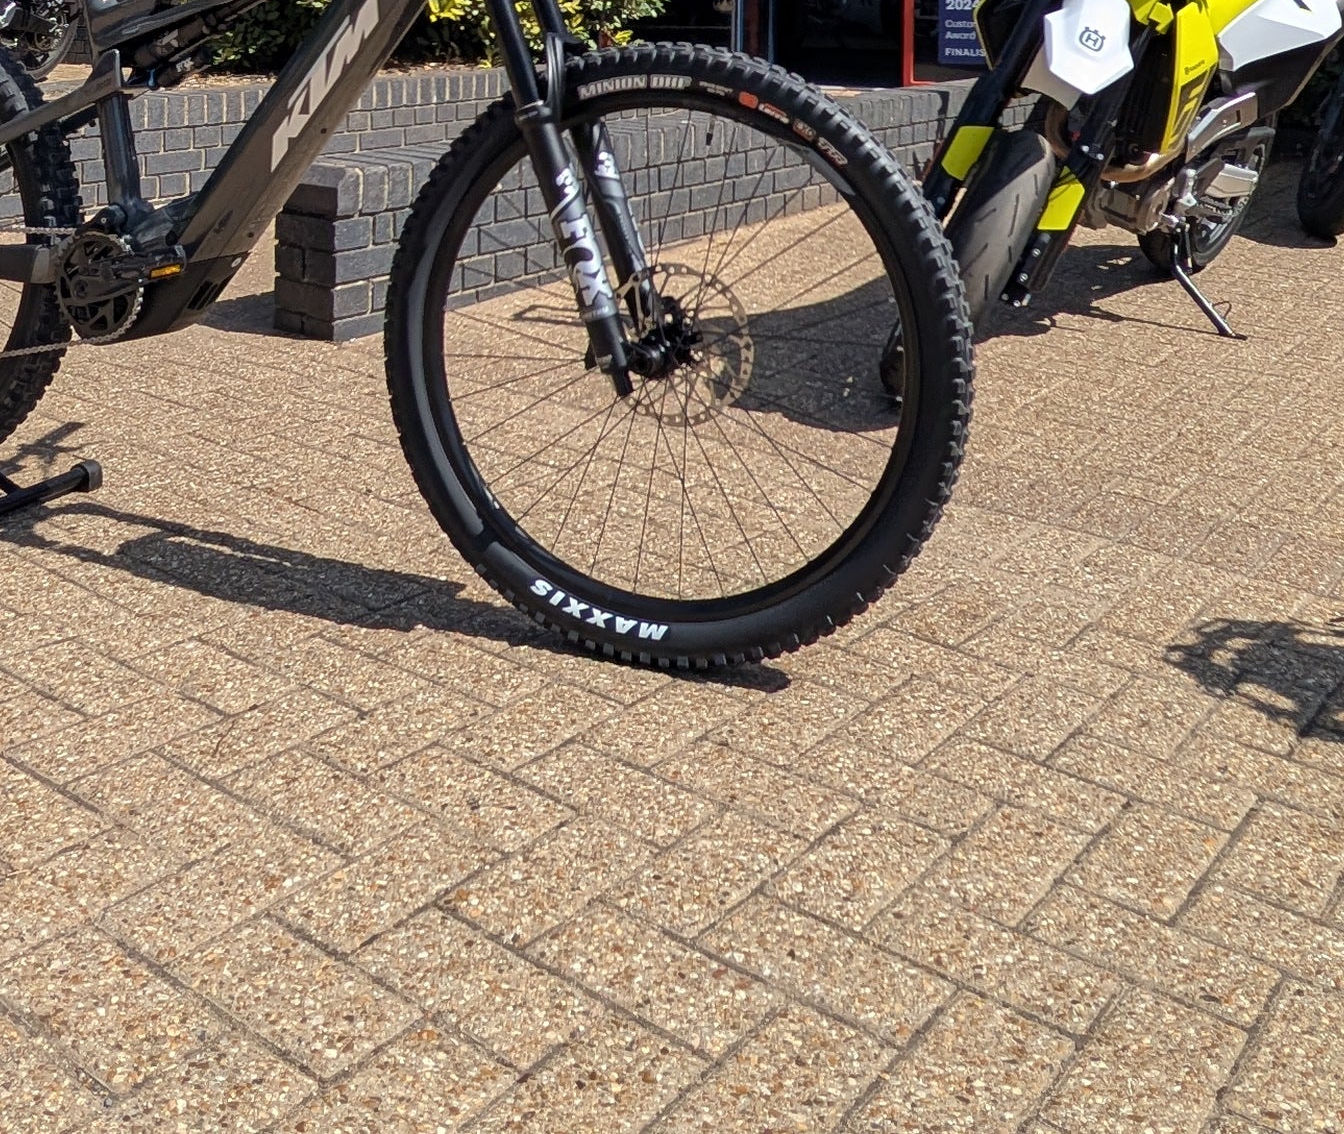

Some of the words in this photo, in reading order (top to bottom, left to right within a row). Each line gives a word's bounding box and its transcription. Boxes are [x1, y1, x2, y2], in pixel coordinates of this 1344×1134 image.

[945, 20, 976, 28] Custo
[945, 48, 986, 56] FINALIS
[577, 74, 647, 101] MINION
[559, 212, 613, 307] FOX
[531, 577, 668, 642] MAXXIS
